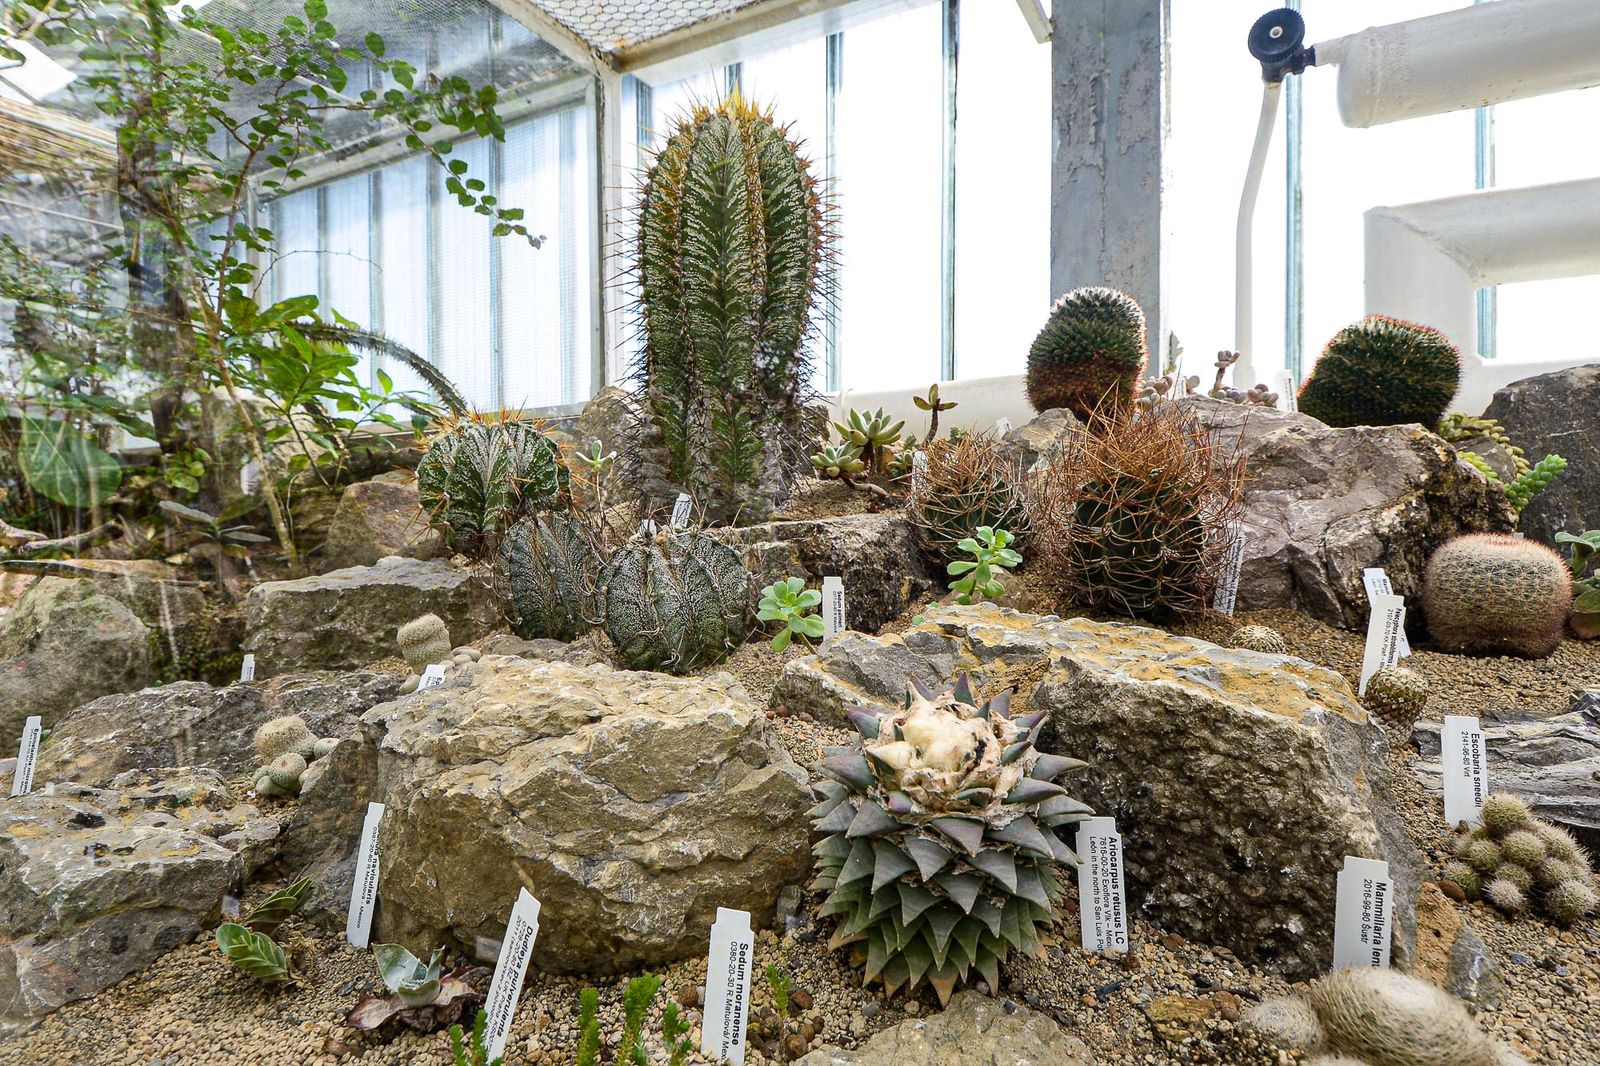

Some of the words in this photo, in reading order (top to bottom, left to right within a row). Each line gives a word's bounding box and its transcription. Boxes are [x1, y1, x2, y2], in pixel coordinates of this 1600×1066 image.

[1392, 608, 1402, 635] Pelecyphora
[1461, 731, 1470, 765] 2141-96-80
[1471, 733, 1481, 774] Escobaria
[1090, 836, 1098, 853] León
[1099, 837, 1109, 877] 7616-00-20
[1109, 837, 1120, 889] Ariocarpus
[366, 858, 379, 905] navicularis
[1093, 877, 1101, 895] north
[1102, 879, 1111, 908] Exoflora
[1362, 879, 1372, 921] 2016-99-80
[1113, 892, 1122, 928] retusus
[1372, 882, 1386, 945] Mammillaria
[516, 925, 534, 969] Dudleya
[1115, 932, 1124, 944] LC
[1361, 924, 1371, 944] Šustr
[737, 943, 749, 980] Sedum
[496, 970, 519, 1038] pulverulenta
[732, 984, 743, 1045] moranense
